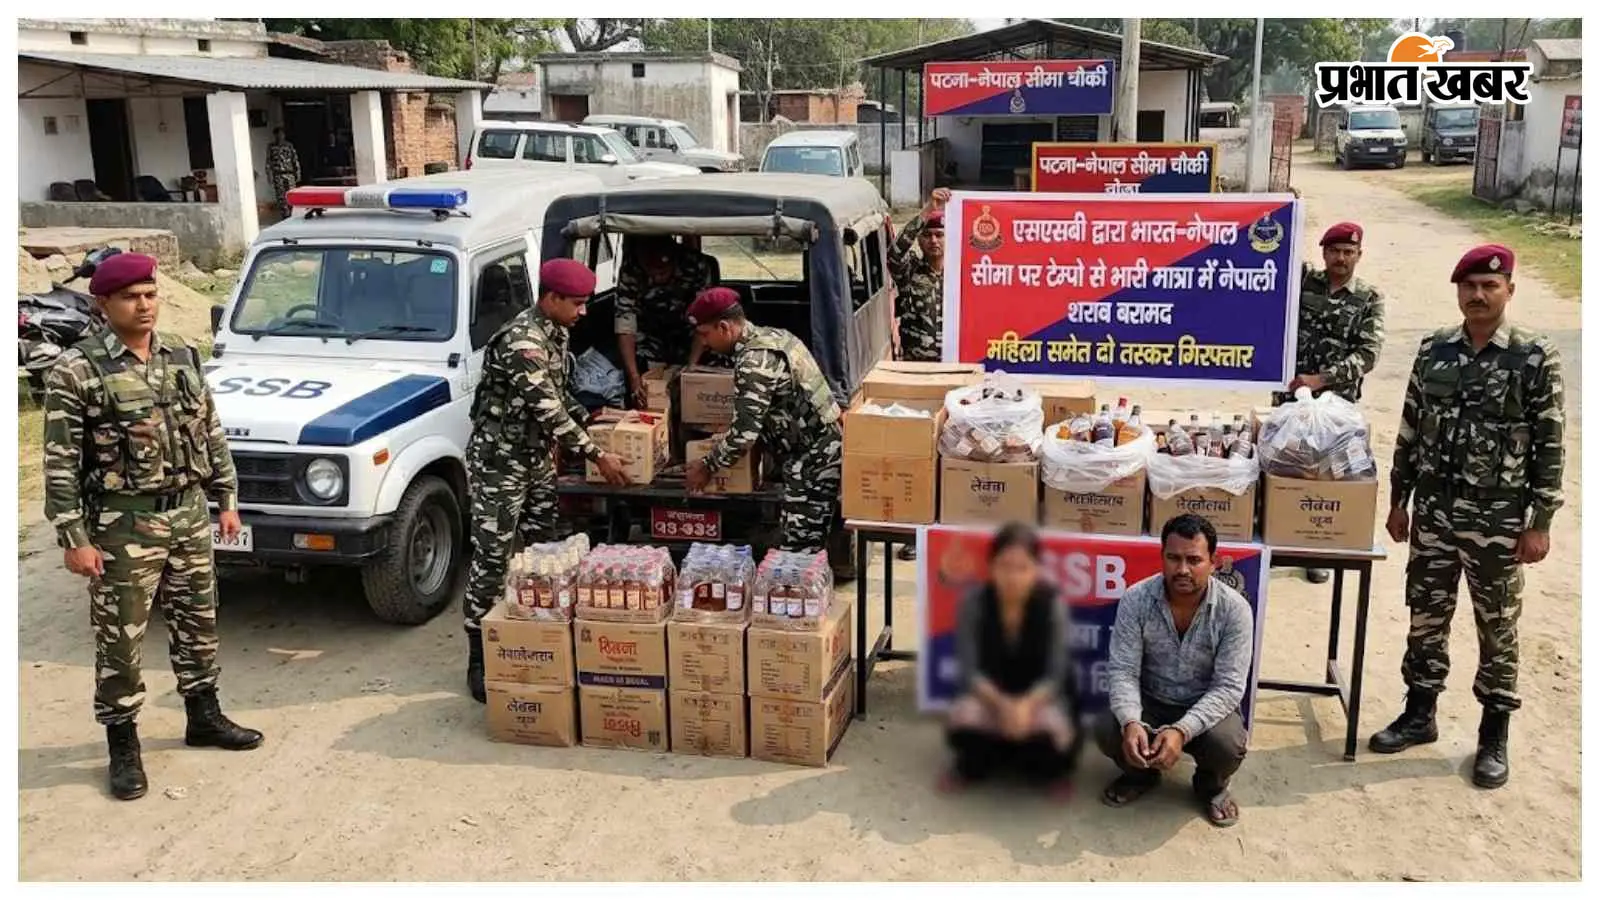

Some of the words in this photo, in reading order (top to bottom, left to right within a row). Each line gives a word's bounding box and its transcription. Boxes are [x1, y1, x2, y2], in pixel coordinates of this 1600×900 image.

[930, 67, 1021, 88] पटना-नेपाल
[1026, 66, 1062, 87] सीमा
[1067, 65, 1108, 87] चौकी
[1039, 152, 1126, 174] पटना-नेपाल
[1131, 152, 1167, 175] सीमा
[1171, 151, 1209, 175] चौकी
[1012, 211, 1086, 244] एसएसबी
[1091, 218, 1126, 246] द्वारा
[1131, 213, 1238, 246] भारत-नेपाल
[971, 255, 1013, 287] सीमा
[1018, 263, 1041, 287] पर
[1046, 258, 1084, 288] टेम्पो
[1089, 258, 1106, 288] से
[1110, 258, 1149, 290] भारी
[1153, 265, 1193, 290] मात्रा
[1198, 259, 1215, 290] में
[1218, 258, 1278, 291] नेपाली
[1116, 301, 1174, 325] बरामद
[986, 330, 1042, 363] महिला
[1047, 334, 1091, 363] समेत
[1096, 334, 1116, 364] दो
[1119, 343, 1175, 366] तस्कर
[212, 377, 332, 399] SSB
